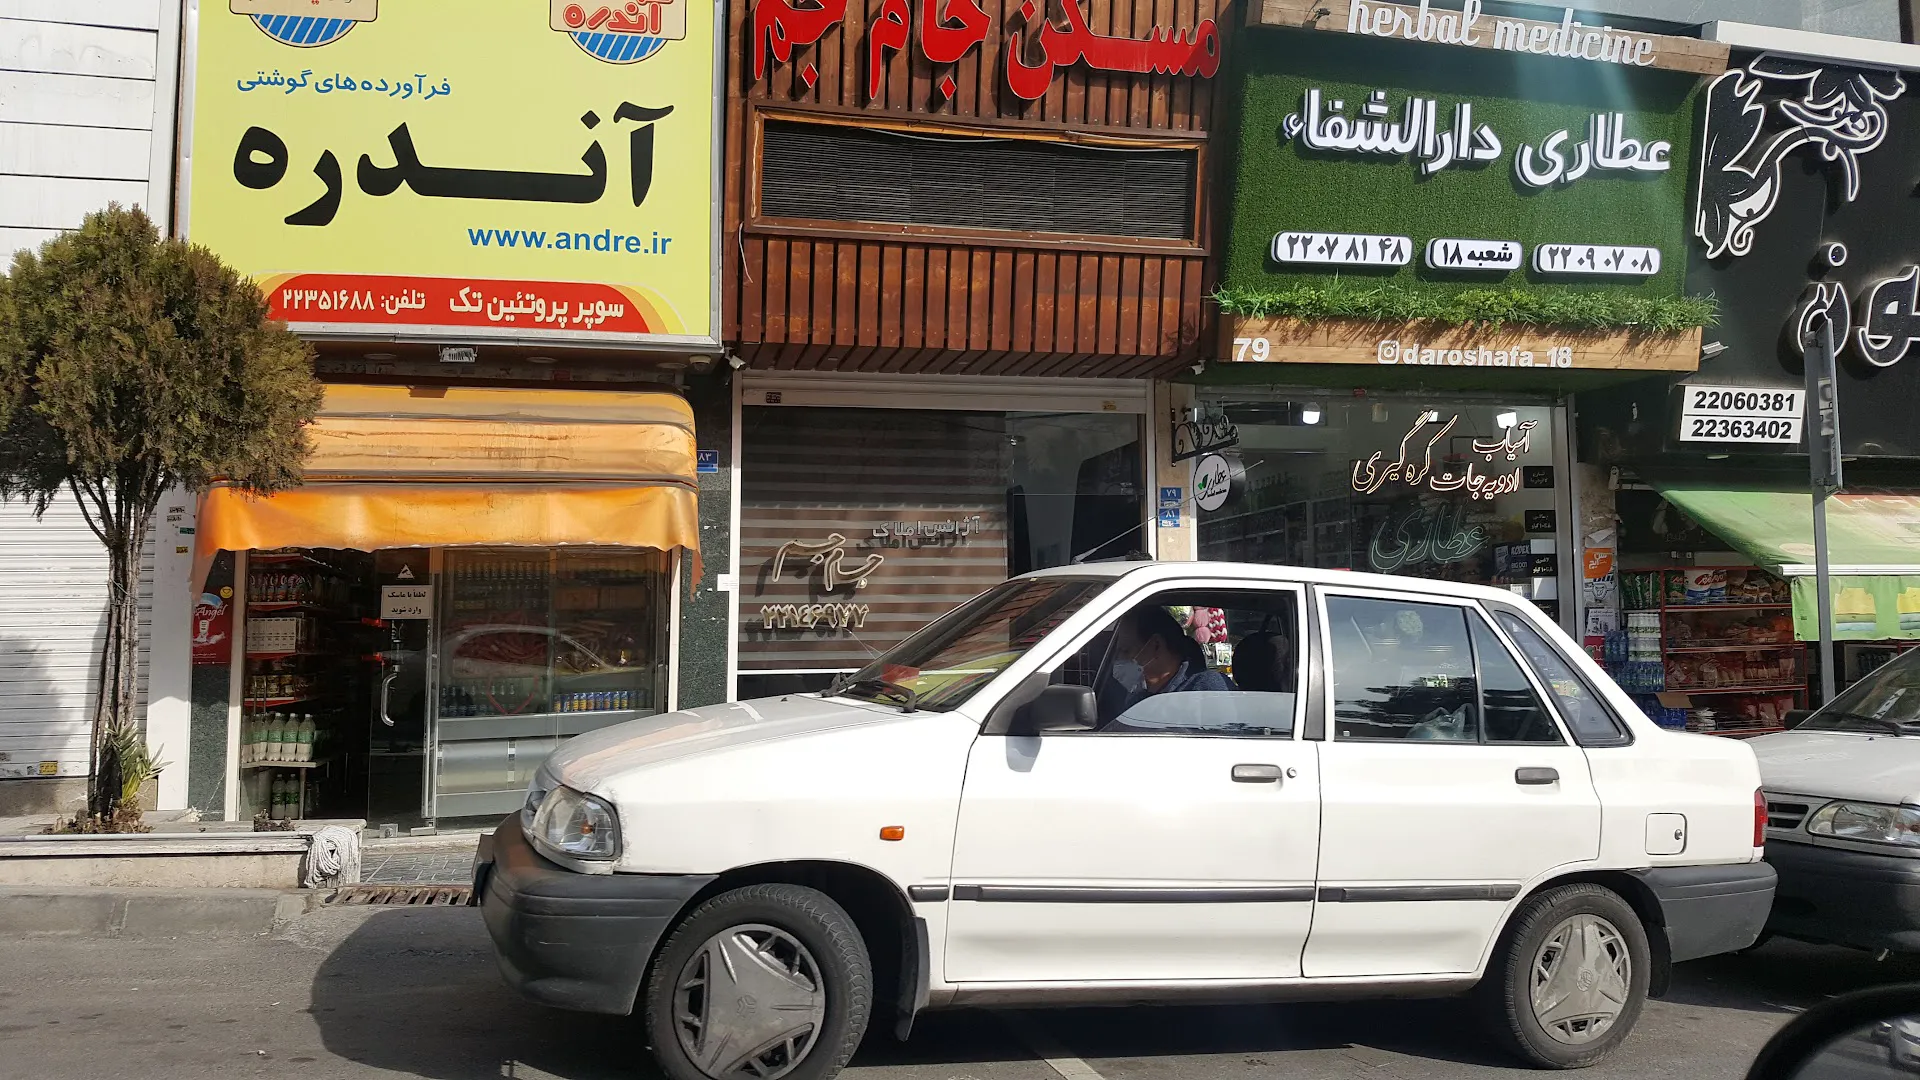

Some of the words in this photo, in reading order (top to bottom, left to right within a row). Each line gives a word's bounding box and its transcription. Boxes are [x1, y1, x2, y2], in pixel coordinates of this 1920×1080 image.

[1347, 0, 1481, 46] herbal
[1493, 8, 1657, 66] medicine
[869, 0, 992, 100] جام
[236, 69, 314, 94] گوشتی
[361, 73, 452, 100] فرآورده
[1515, 112, 1671, 187] عطاری
[232, 101, 675, 226] آندره
[468, 228, 672, 256] www.andre.ir
[1442, 242, 1463, 266] ۱۸
[1467, 243, 1513, 266] شعبه
[282, 289, 375, 311] ۲۲۳۵۱۶۸۸
[380, 290, 426, 315] تلفن:
[449, 287, 483, 312] تک
[487, 294, 569, 327] پروتئین
[572, 302, 625, 329] سوپر
[1233, 338, 1270, 362] 79
[1403, 343, 1573, 368] daroshafa_18
[1693, 390, 1795, 412] 22060381
[1472, 420, 1538, 462] آسیاب
[1691, 418, 1792, 439] 22363402
[1369, 504, 1492, 574] عطاری
[408, 606, 422, 615] وارد
